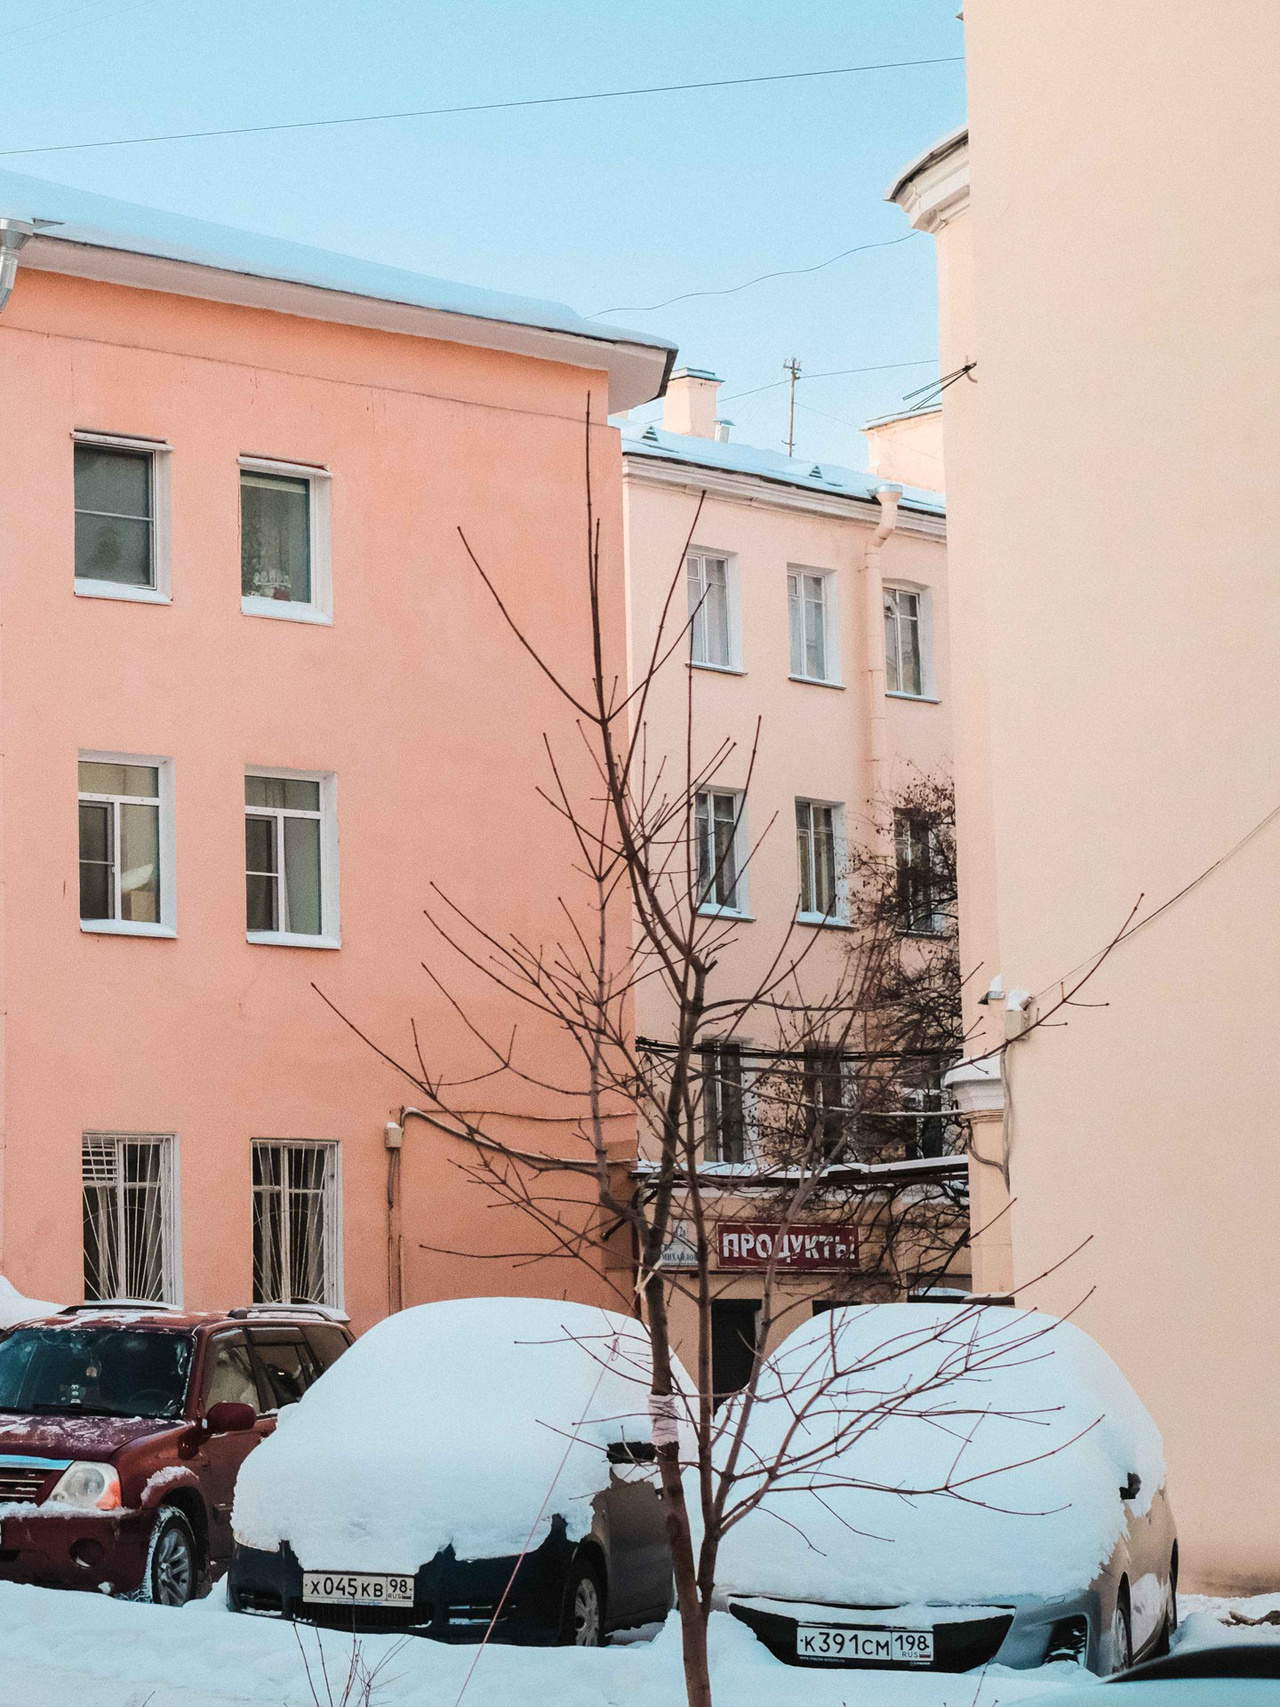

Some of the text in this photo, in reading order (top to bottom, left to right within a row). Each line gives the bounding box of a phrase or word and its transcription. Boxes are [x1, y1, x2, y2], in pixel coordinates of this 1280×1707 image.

[723, 1233, 856, 1263] ПРОДУКТЫ
[390, 1579, 407, 1593] 98
[895, 1635, 927, 1651] 198
